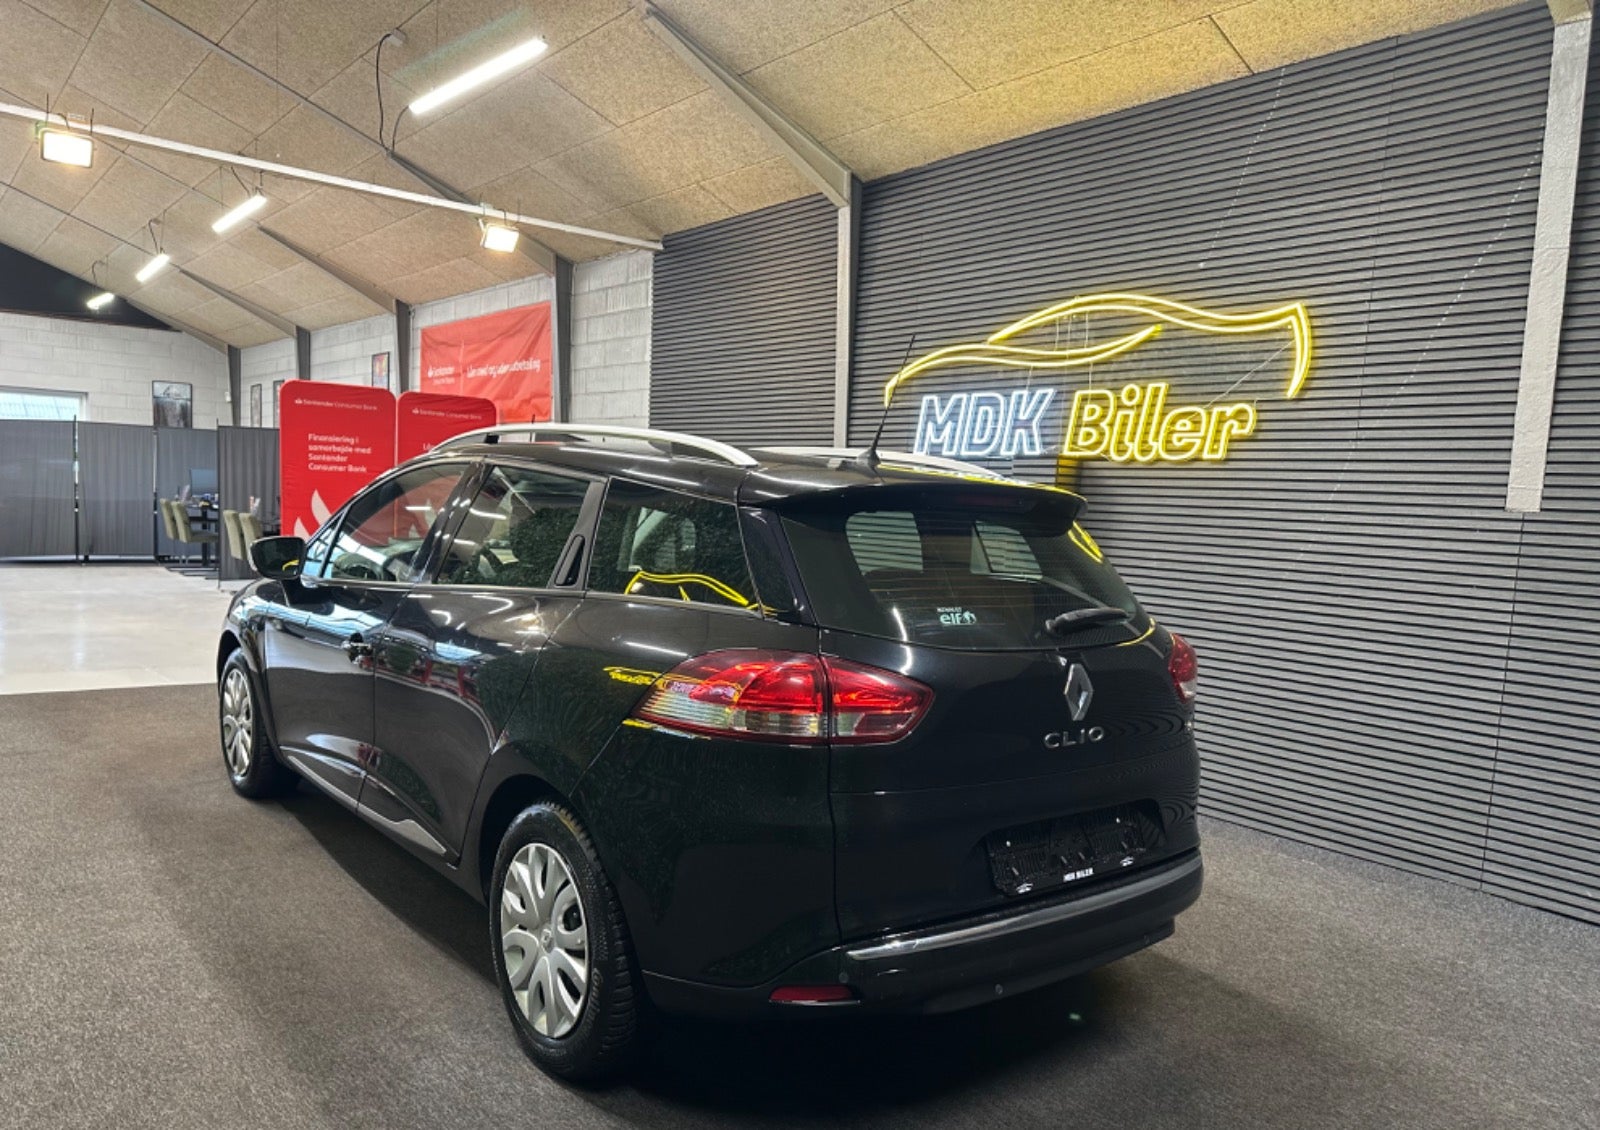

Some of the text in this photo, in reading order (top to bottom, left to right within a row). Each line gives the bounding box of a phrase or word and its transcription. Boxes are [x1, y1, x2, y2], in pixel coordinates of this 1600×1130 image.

[912, 382, 1257, 463] MDK Biler
[308, 433, 354, 445] Finansiering
[308, 445, 372, 454] samarbejde med
[308, 453, 348, 462] Santander
[308, 462, 367, 473] Consumer Bank
[940, 613, 962, 625] elf
[1044, 726, 1105, 749] CLIO
